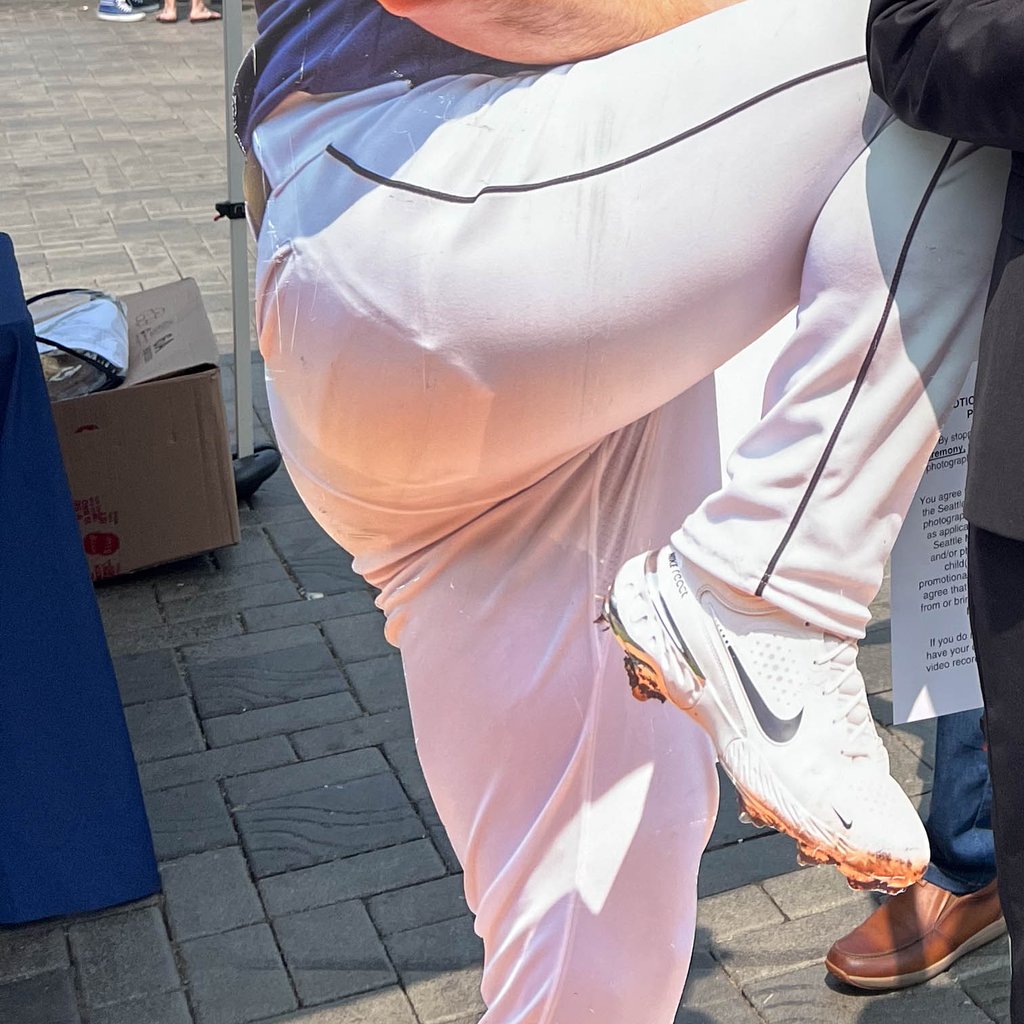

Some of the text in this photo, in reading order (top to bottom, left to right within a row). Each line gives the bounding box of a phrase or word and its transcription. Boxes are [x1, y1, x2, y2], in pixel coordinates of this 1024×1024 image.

[919, 489, 962, 505] You agree
[922, 506, 936, 517] the
[927, 531, 937, 540] as
[933, 536, 963, 550] Seattle
[930, 549, 958, 562] and/or
[923, 584, 967, 601] agree that
[920, 600, 941, 613] from
[942, 599, 952, 608] or
[929, 631, 968, 647] If you do
[926, 644, 970, 660] have your
[925, 660, 950, 673] video
